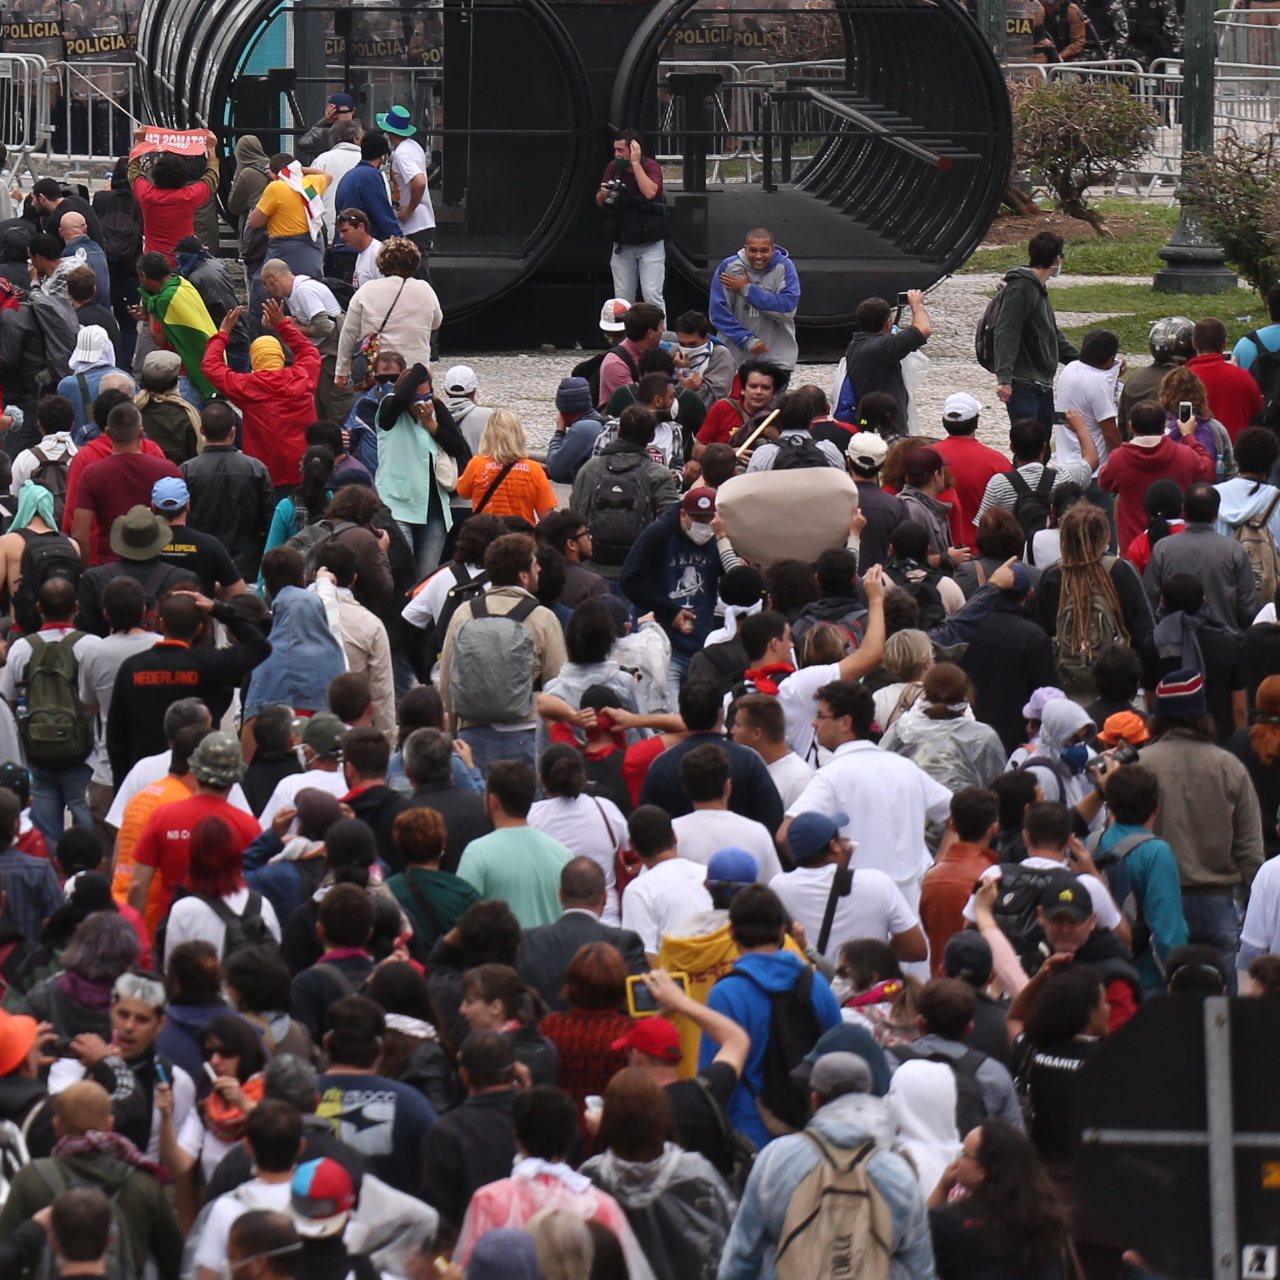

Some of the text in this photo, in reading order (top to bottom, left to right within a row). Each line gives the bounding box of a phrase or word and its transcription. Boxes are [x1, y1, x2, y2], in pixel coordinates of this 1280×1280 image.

[3, 21, 60, 39] POLICIA
[67, 35, 127, 54] POLICIA
[133, 670, 198, 686] NEDERLAND
